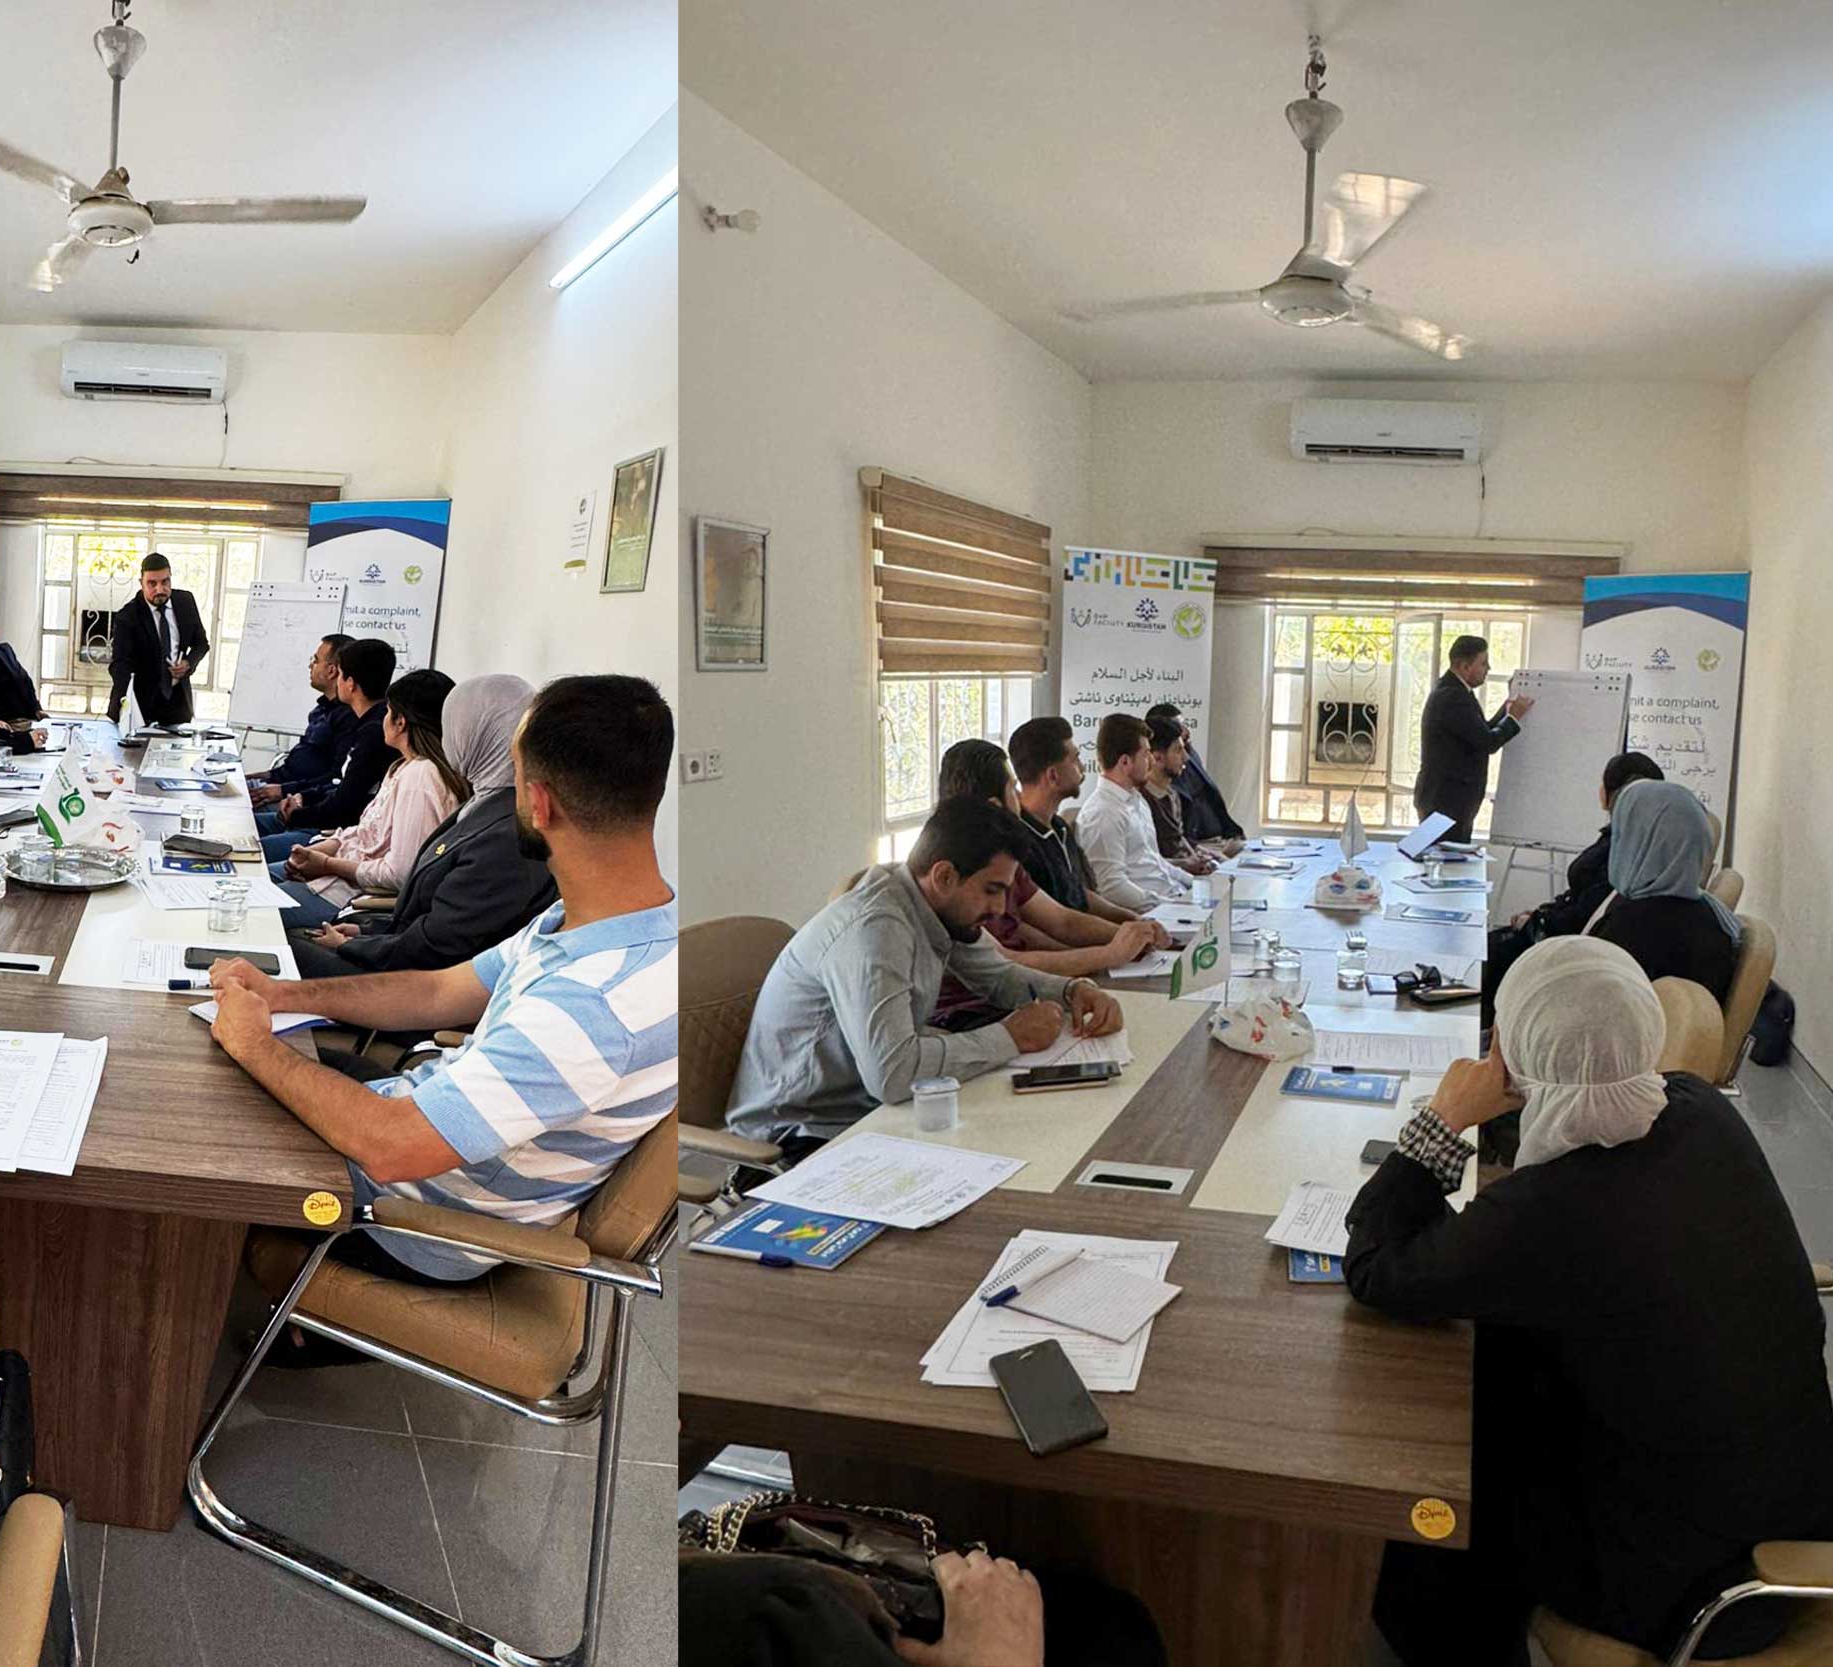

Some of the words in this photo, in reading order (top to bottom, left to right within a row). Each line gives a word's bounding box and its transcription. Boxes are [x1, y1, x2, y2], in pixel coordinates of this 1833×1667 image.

[368, 606, 421, 617] complaint,
[355, 620, 392, 630] contact
[394, 622, 406, 630] us
[1657, 697, 1720, 710] complaint,
[1642, 714, 1685, 725] contact
[1688, 716, 1702, 725] us
